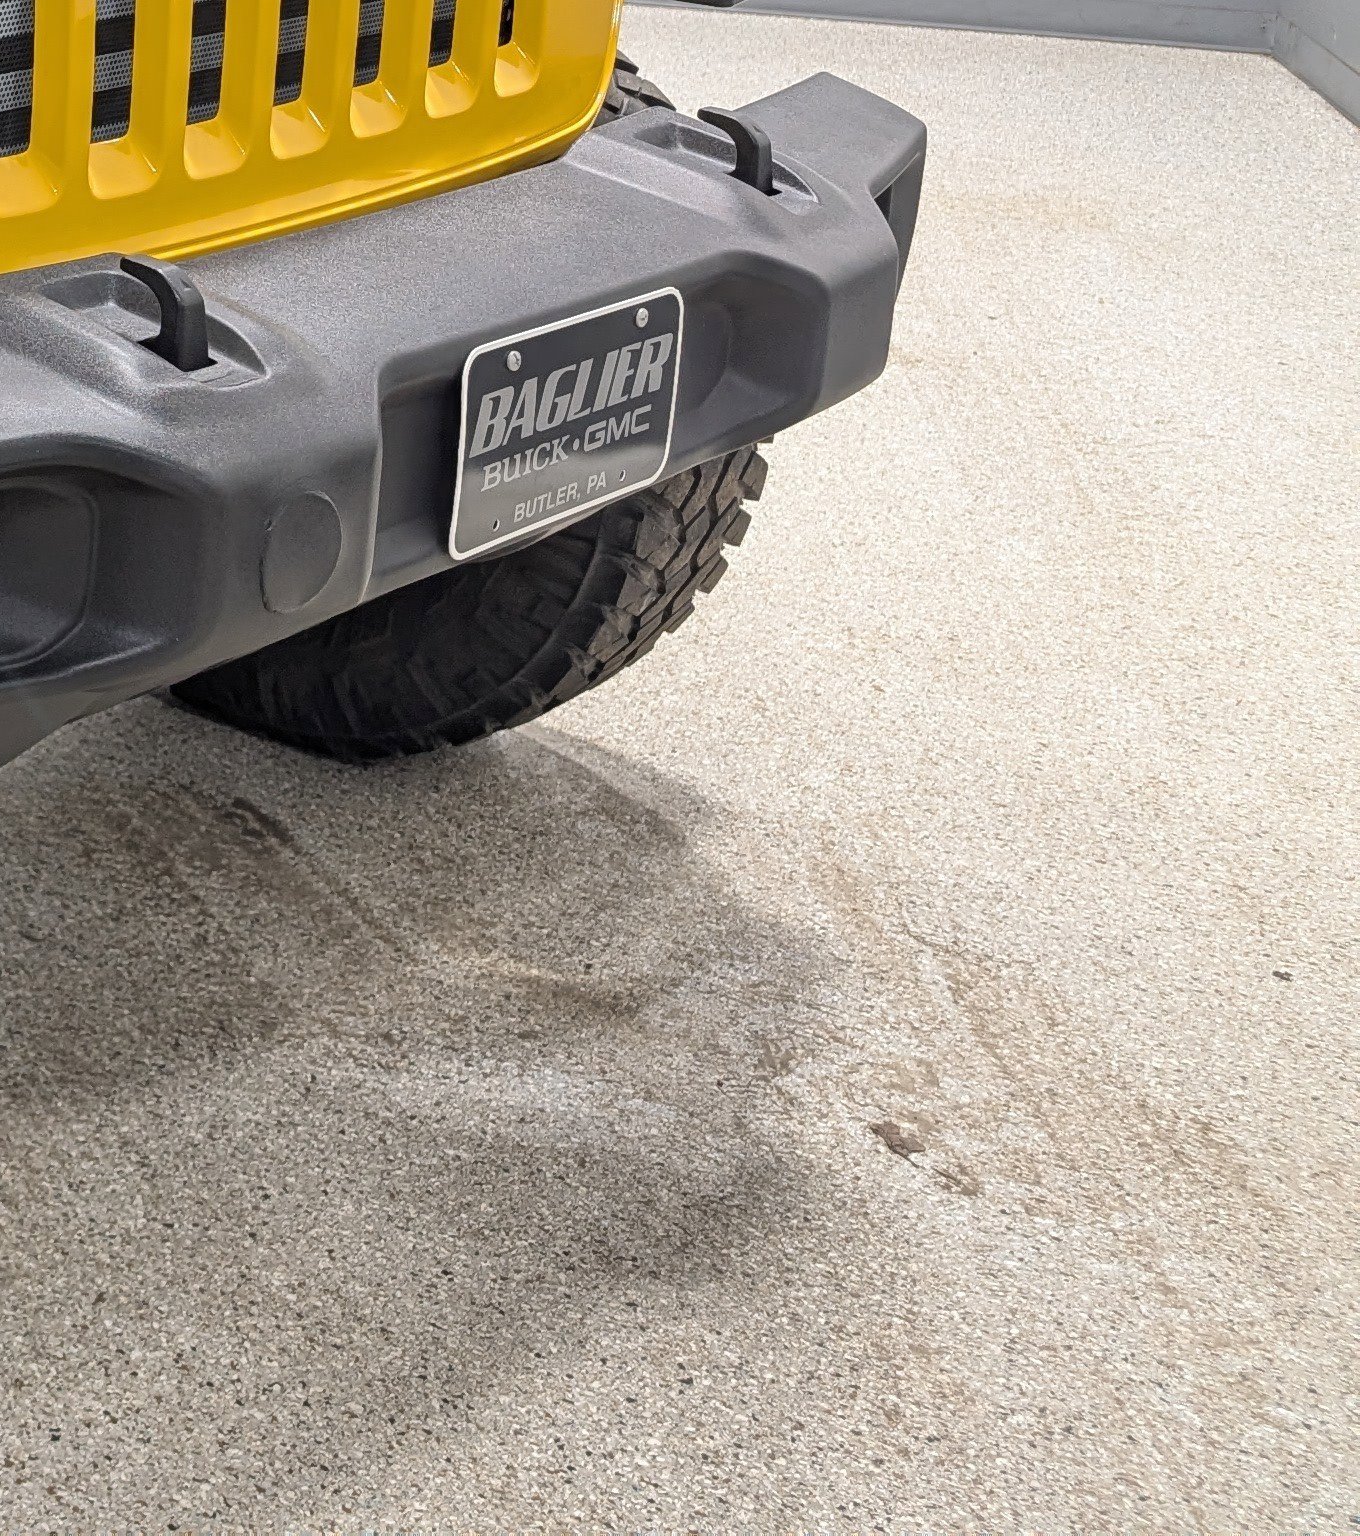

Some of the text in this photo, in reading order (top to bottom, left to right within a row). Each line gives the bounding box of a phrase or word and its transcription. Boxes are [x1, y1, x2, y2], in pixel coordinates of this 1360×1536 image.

[469, 332, 674, 459] BAGLIER
[481, 404, 652, 493] BUICK GMC
[513, 472, 607, 524] BUTLER, PA
